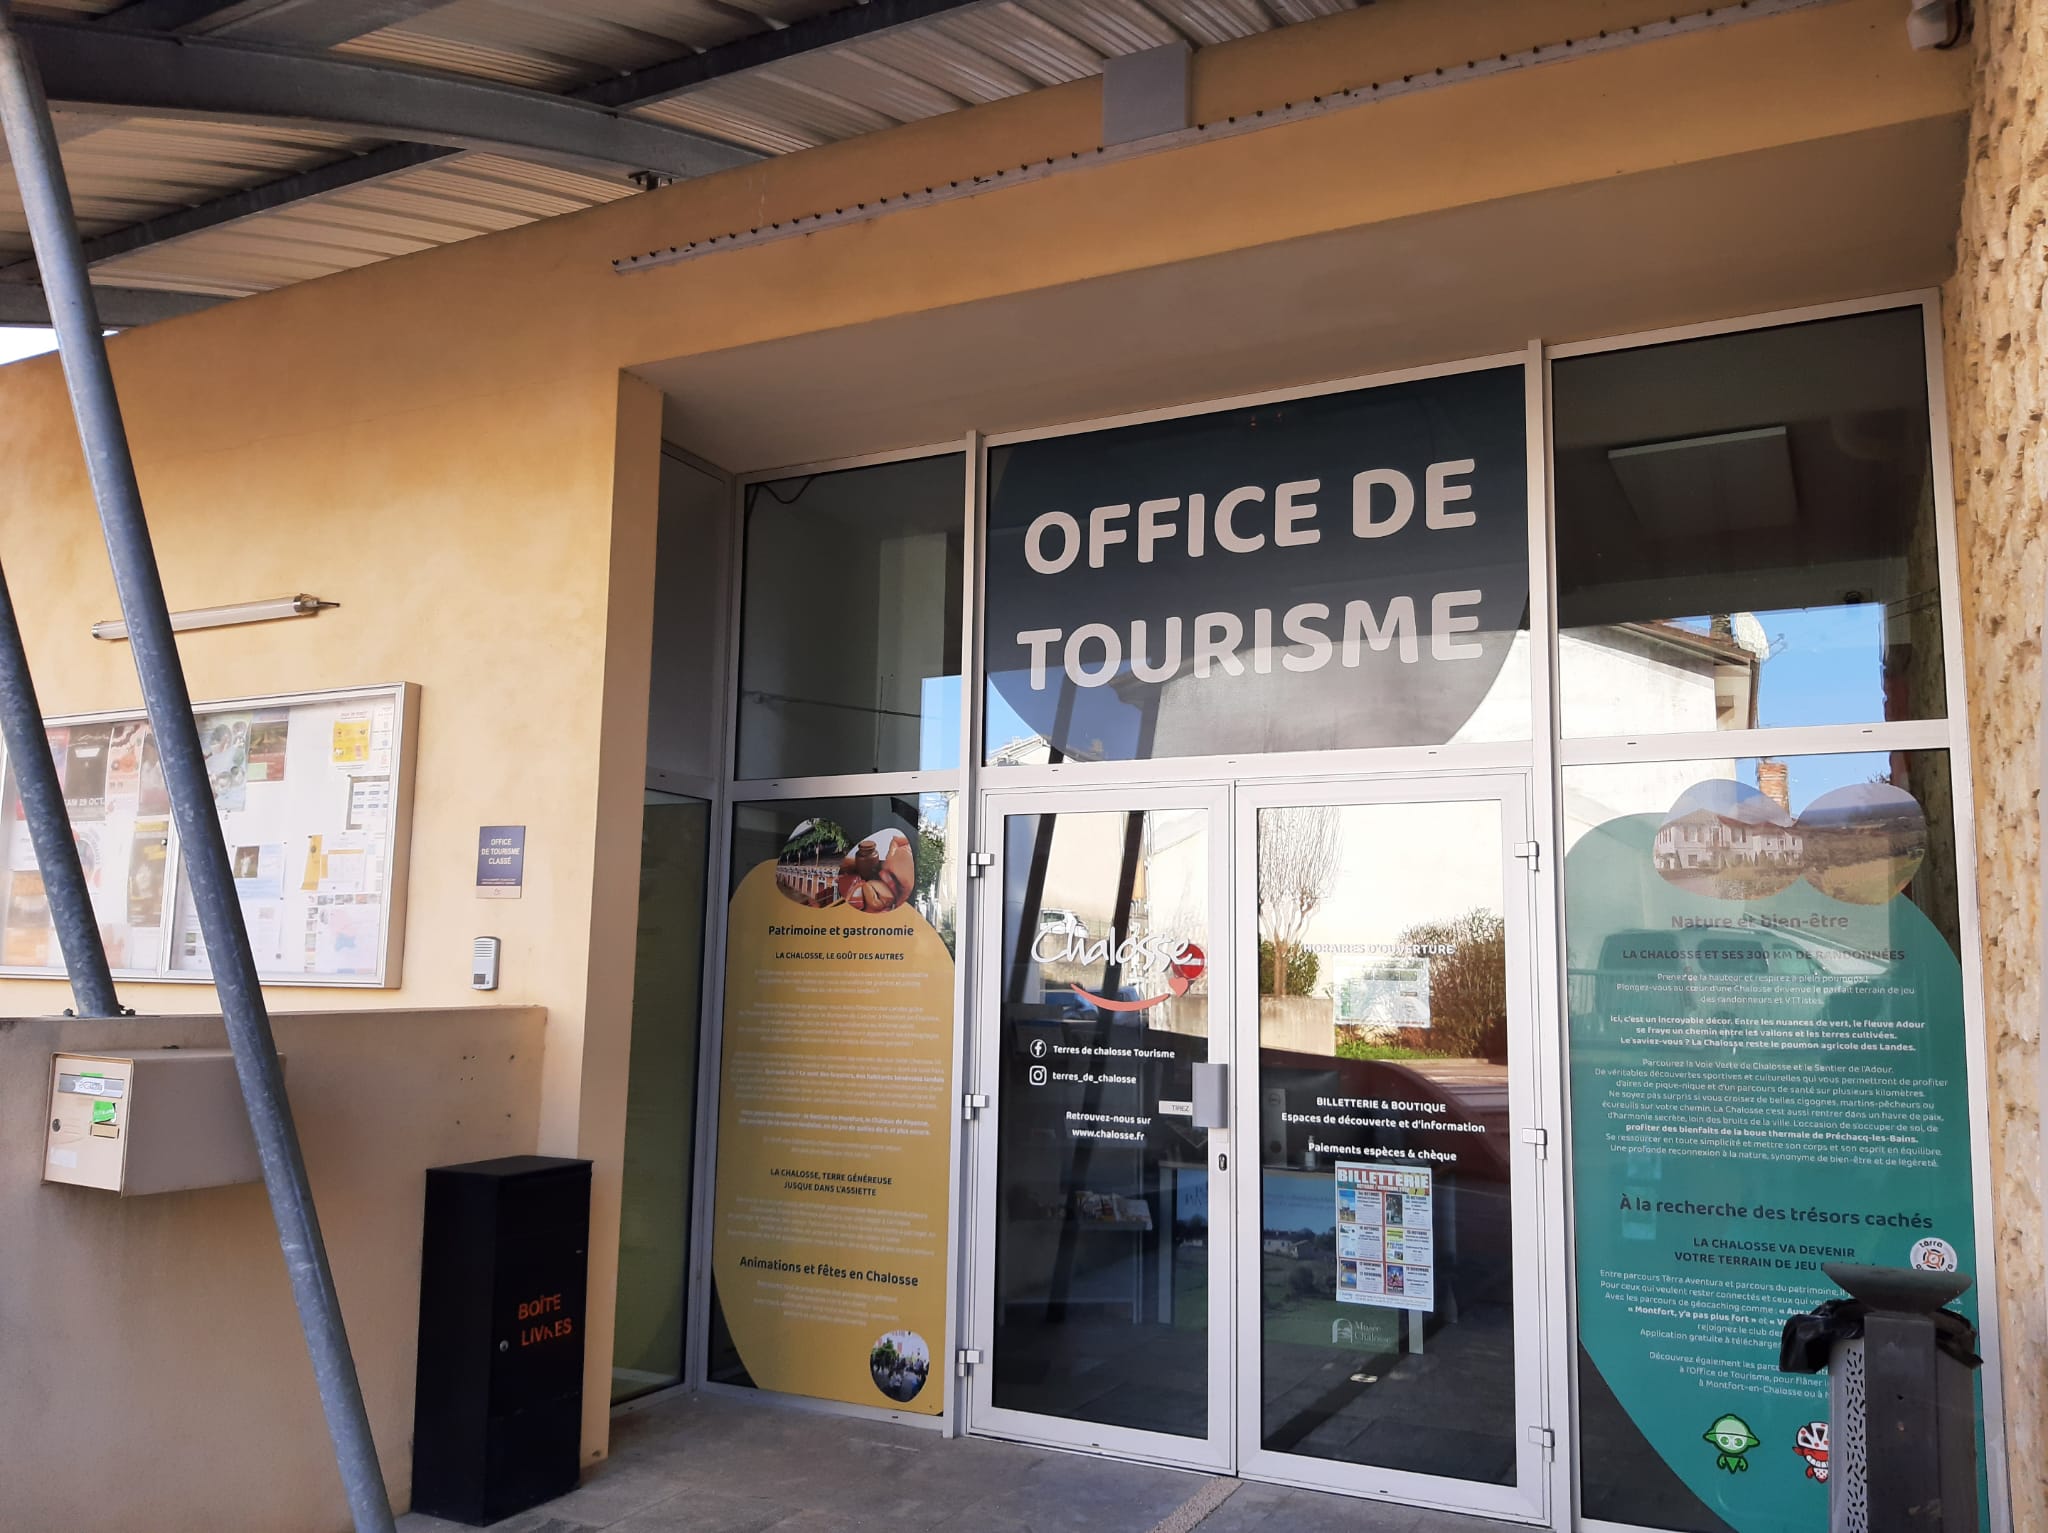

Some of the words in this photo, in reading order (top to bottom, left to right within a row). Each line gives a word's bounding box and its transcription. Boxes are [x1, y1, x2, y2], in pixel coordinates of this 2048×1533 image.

[1024, 478, 1320, 575] OFFICE
[1353, 458, 1477, 538] DE
[1016, 589, 1483, 690] TOURISME
[488, 856, 512, 864] CLASSÉ
[1672, 915, 1732, 928] Nature
[1738, 916, 1752, 928] et
[1760, 913, 1849, 928] bien-être
[768, 925, 826, 934] Patrimoine
[829, 925, 840, 934] et
[842, 925, 913, 937] gastronomie
[1031, 915, 1193, 972] Chalosse
[1302, 943, 1366, 954] HORAIRES
[1368, 944, 1456, 954] D'OUVERTURE
[785, 952, 824, 960] CHALOSSE,
[835, 951, 856, 959] GOÛT
[1622, 951, 1637, 959] LA
[1639, 951, 1701, 959] CHALOSSE
[1704, 951, 1717, 959] ET
[1721, 951, 1743, 959] SES
[1746, 951, 1769, 959] 300
[1774, 951, 1792, 959] KM
[1796, 951, 1812, 959] DE
[1816, 949, 1904, 960] RANDONNÉES
[1610, 1015, 1622, 1024] Ici,
[1658, 1016, 1704, 1026] incroyable
[1705, 1017, 1732, 1025] décor.
[1734, 1017, 1759, 1025] Entre
[1828, 1019, 1851, 1028] vert,
[1852, 1019, 1862, 1027] le
[1863, 1019, 1894, 1027] fleuve
[1895, 1020, 1924, 1028] Adour
[1647, 1026, 1670, 1036] fraye
[1684, 1027, 1717, 1035] chemin
[1718, 1028, 1743, 1036] entre
[1744, 1028, 1758, 1036] les
[1760, 1028, 1793, 1036] vallons
[1794, 1029, 1804, 1037] et
[1806, 1029, 1819, 1037] les
[1821, 1030, 1850, 1038] terres
[1851, 1030, 1897, 1038] cultivées.
[1053, 1044, 1079, 1054] Terres
[1081, 1045, 1092, 1055] de
[1093, 1045, 1131, 1056] chalosse
[1133, 1047, 1175, 1058] Tourisme
[1620, 1037, 1631, 1045] Le
[1630, 1037, 1683, 1046] saviez-vous
[1691, 1038, 1702, 1046] La
[1703, 1039, 1743, 1047] Chalosse
[1770, 1040, 1779, 1048] le
[1780, 1042, 1819, 1050] poumon
[1820, 1041, 1858, 1051] agricole
[1879, 1042, 1915, 1050] Landes.
[1052, 1070, 1136, 1085] terres_de_chalosse
[1316, 1097, 1378, 1108] BILLETTERIE
[1390, 1101, 1446, 1113] BOUTIQUE
[1065, 1110, 1134, 1123] Retrouvez-nous
[1136, 1116, 1150, 1124] sur
[1281, 1111, 1321, 1125] Espaces
[1322, 1113, 1335, 1124] de
[1337, 1114, 1396, 1127] découverte
[1398, 1117, 1409, 1127] et
[1411, 1118, 1485, 1131] d'information
[1071, 1127, 1144, 1139] www.chalosse.fr
[1625, 1123, 1659, 1134] profiter
[1661, 1125, 1677, 1133] des
[1678, 1125, 1718, 1134] bienfaits
[1720, 1127, 1732, 1135] de
[1743, 1128, 1766, 1136] boue
[1768, 1129, 1810, 1138] thermale
[1811, 1131, 1823, 1139] de
[1825, 1131, 1918, 1144] Préchacq-les-Bains.
[1308, 1142, 1361, 1154] Paiements
[1363, 1145, 1405, 1159] espèces
[1417, 1148, 1456, 1162] chèque
[780, 1169, 820, 1180] CHALOSSE,
[822, 1172, 845, 1180] TERRE
[846, 1172, 892, 1184] GÉNÉREUSE
[1337, 1168, 1429, 1188] BILLETTERIE
[784, 1182, 812, 1192] JUSQUE
[813, 1184, 834, 1192] DANS
[835, 1186, 876, 1195] L'ASSIETTE
[1619, 1193, 1631, 1210] À
[1636, 1198, 1651, 1211] la
[1656, 1199, 1747, 1216] recherche
[1752, 1204, 1785, 1219] des
[1790, 1206, 1859, 1223] trésors
[1864, 1210, 1932, 1227] cachés
[1693, 1239, 1708, 1247] LA
[1711, 1240, 1775, 1251] CHALOSSE
[1778, 1244, 1796, 1253] VA
[1799, 1245, 1854, 1256] DEVENIR
[1674, 1252, 1714, 1263] VOTRE
[1718, 1255, 1771, 1266] TERRAIN
[1774, 1259, 1790, 1268] DE
[1794, 1260, 1816, 1269] JEU
[739, 1255, 801, 1272] Animations
[803, 1262, 814, 1274] et
[817, 1264, 846, 1277] fêtes
[849, 1270, 863, 1279] en
[865, 1269, 918, 1285] Chalosse
